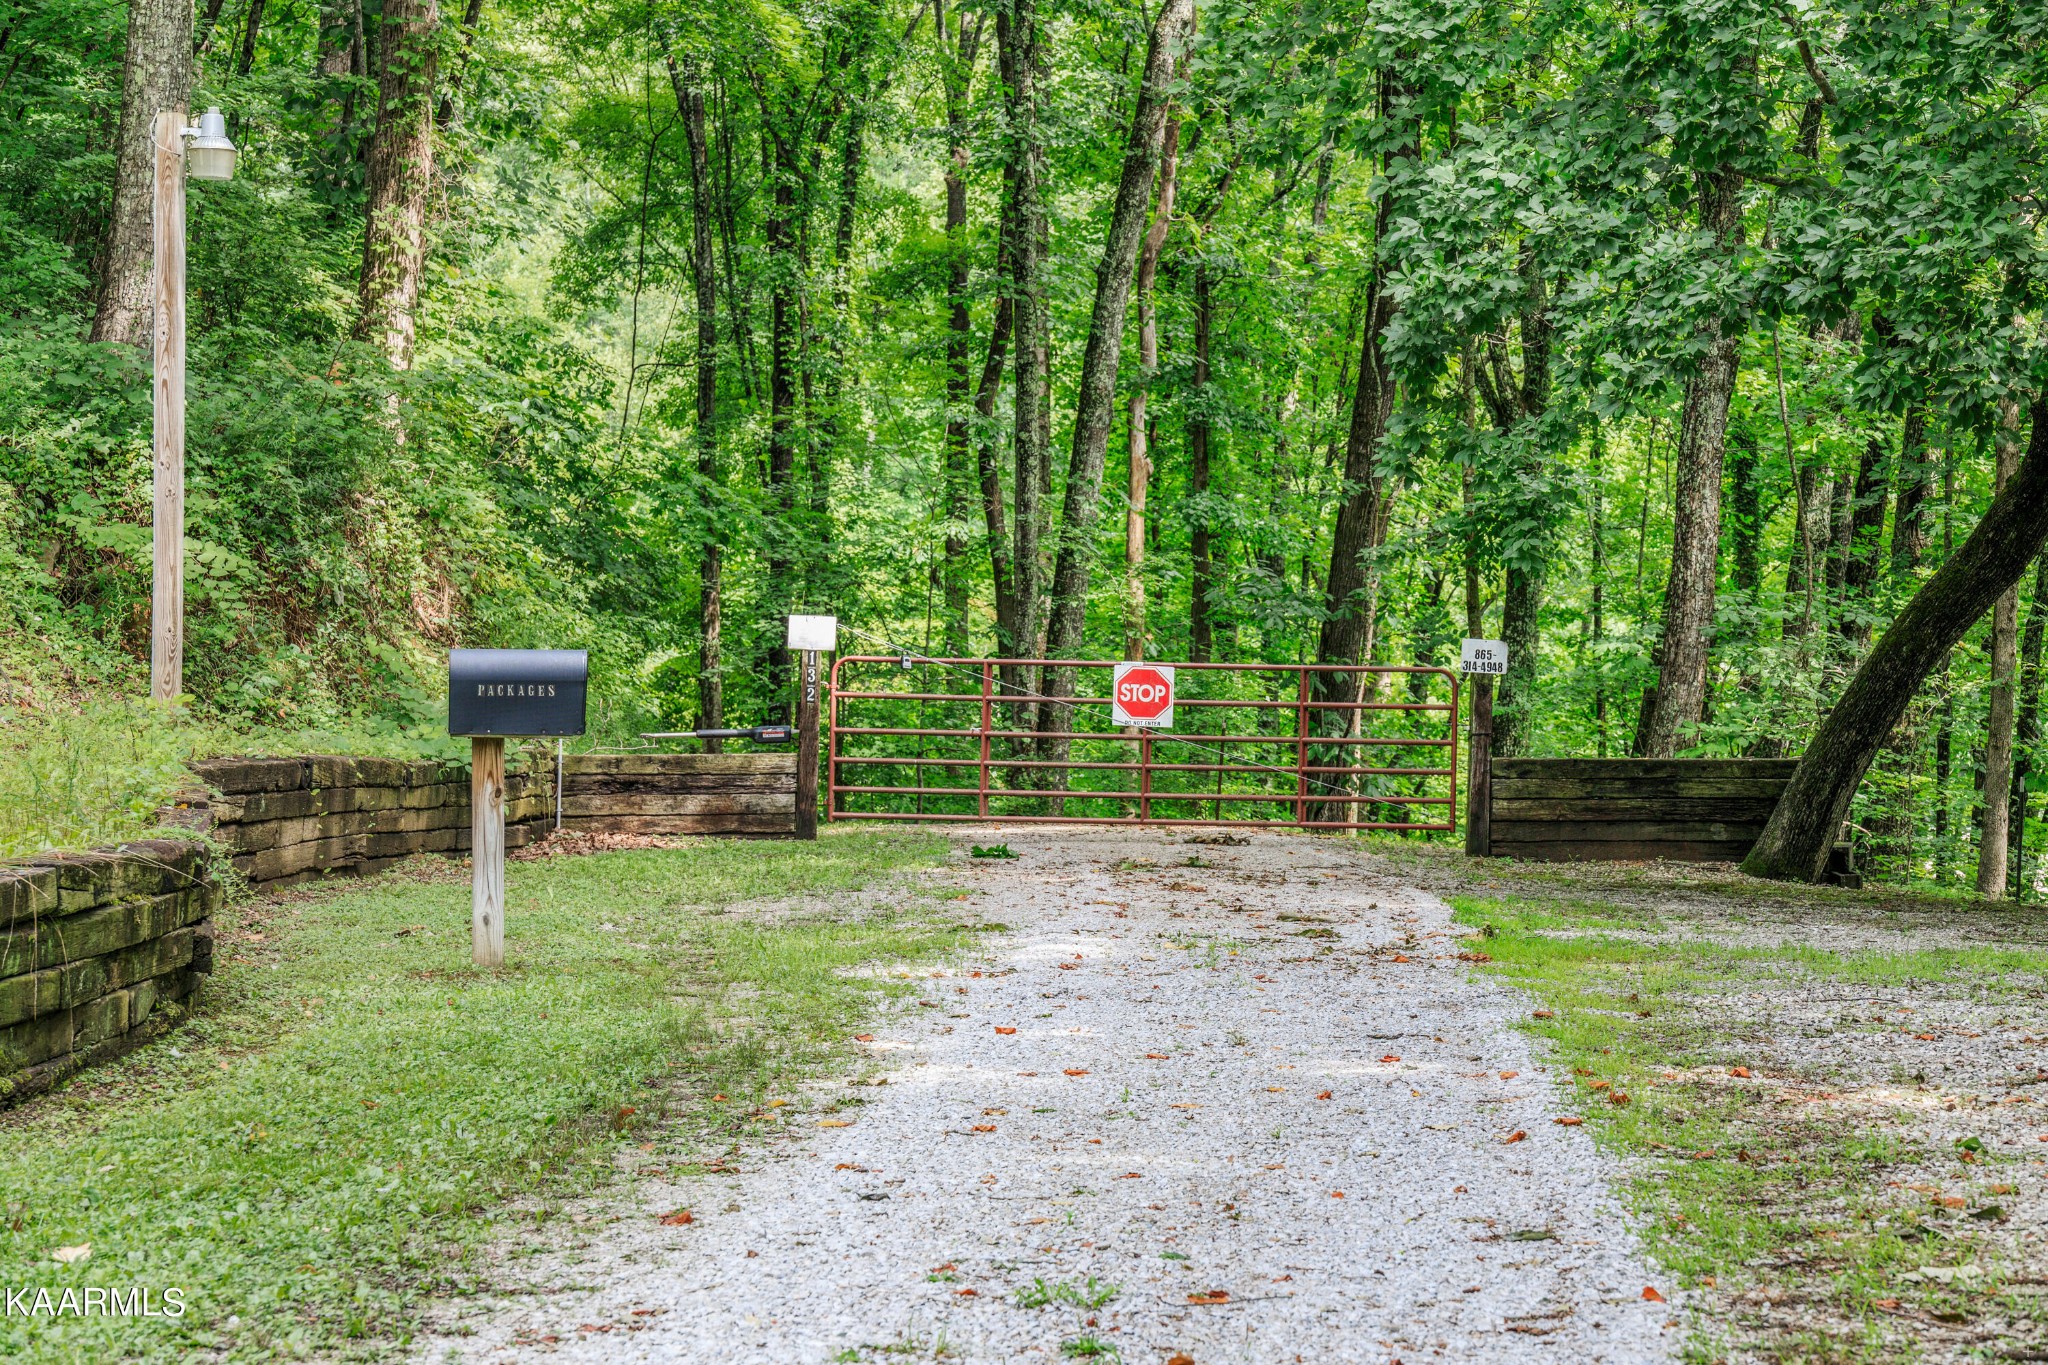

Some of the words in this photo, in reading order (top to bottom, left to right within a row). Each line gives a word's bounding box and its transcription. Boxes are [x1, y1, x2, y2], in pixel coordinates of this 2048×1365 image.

[1474, 649, 1497, 660] 865-
[1462, 660, 1503, 673] 314-4948
[806, 651, 816, 701] 132
[477, 684, 555, 696] PACKAGES
[1119, 683, 1166, 703] STOP
